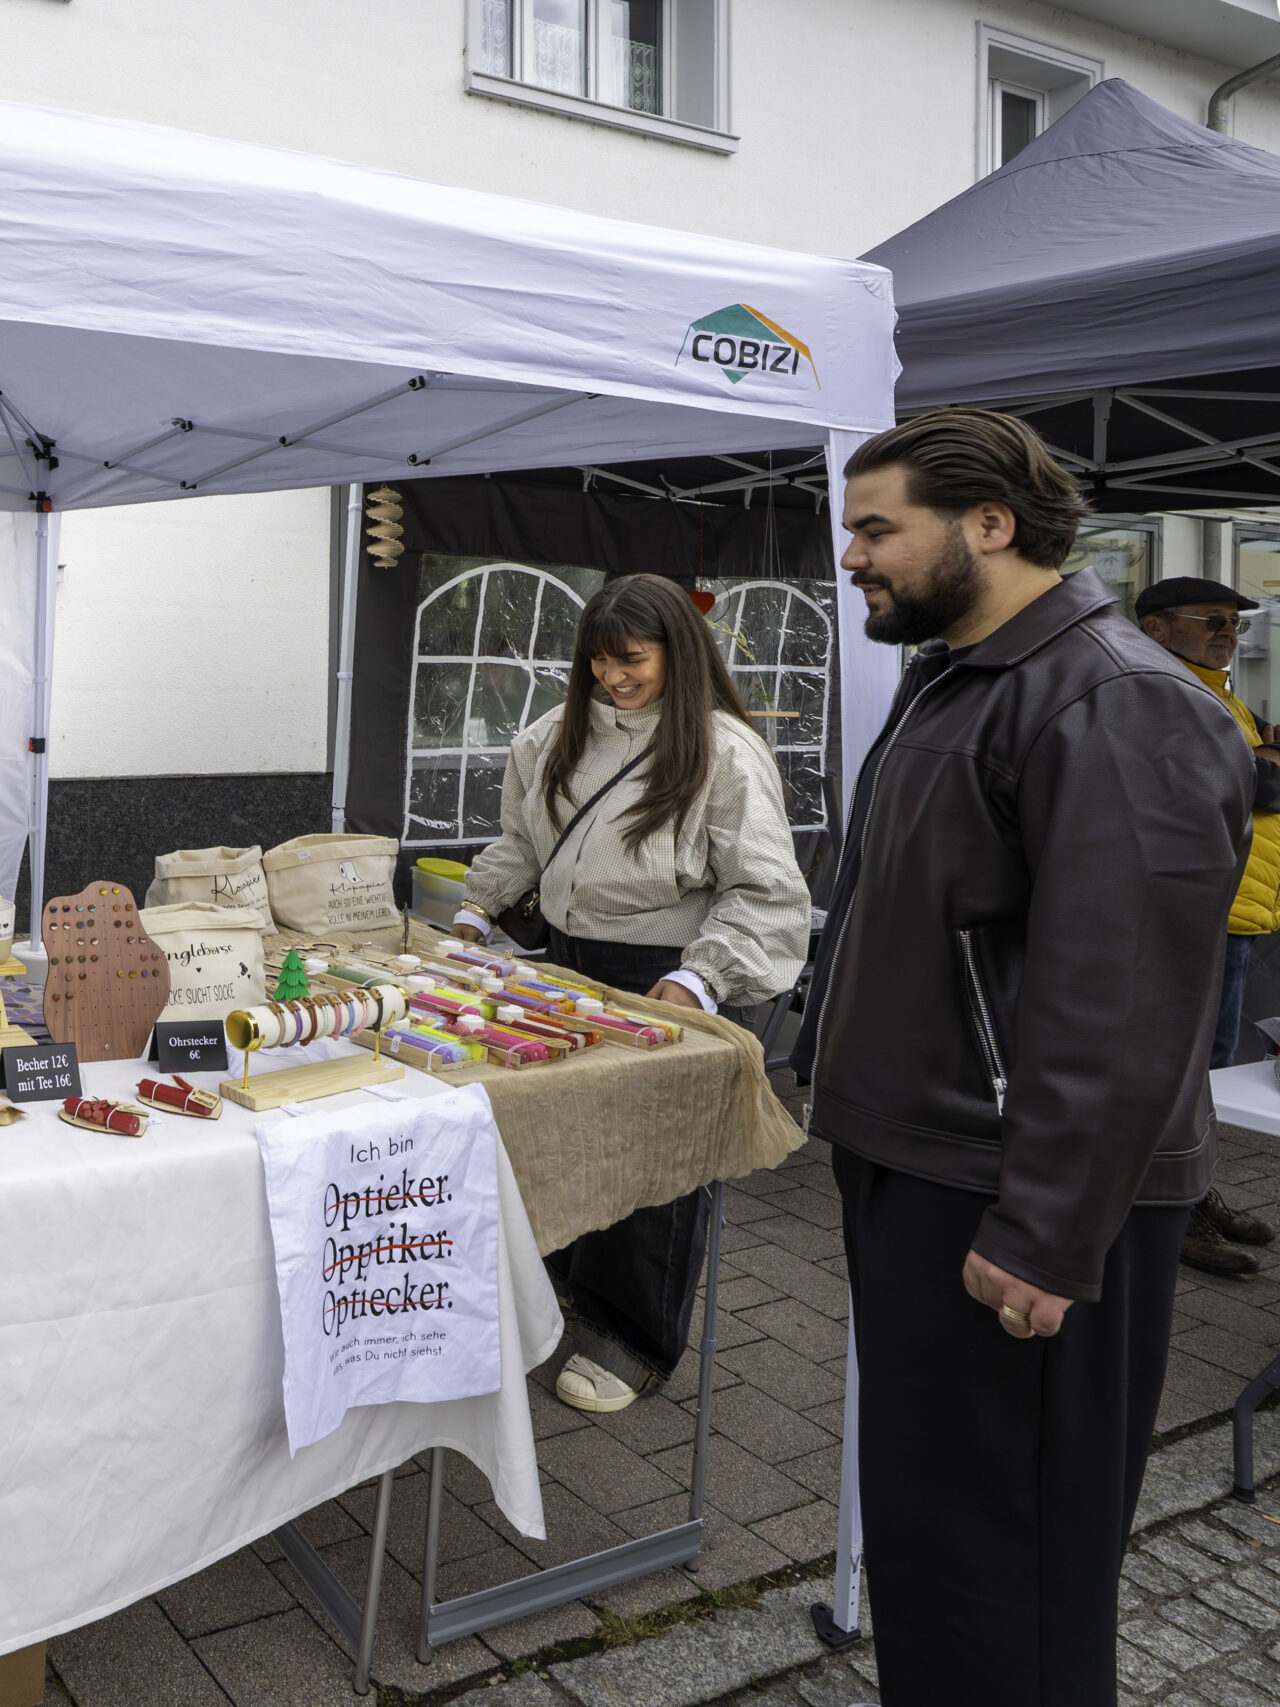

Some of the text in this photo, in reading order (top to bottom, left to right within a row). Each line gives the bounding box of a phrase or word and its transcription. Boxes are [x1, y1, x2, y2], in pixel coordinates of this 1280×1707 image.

[692, 334, 800, 376] COBIZI
[166, 982, 236, 1007] CKE SUCHT SOCKE
[169, 1036, 218, 1047] Ohrstecker
[16, 1055, 69, 1073] Becher 12€
[189, 1049, 201, 1060] 6€
[18, 1073, 72, 1092] mit Tee 16€
[351, 1134, 414, 1164] Ich bin
[323, 1167, 453, 1232] Optieker.
[323, 1222, 453, 1286] Opptiker.
[322, 1273, 453, 1338] Optiecker.
[341, 1337, 360, 1352] auch
[402, 1331, 417, 1342] ich
[421, 1330, 447, 1341] sehe
[345, 1354, 361, 1366] was
[365, 1350, 380, 1361] Du
[383, 1347, 407, 1360] nicht
